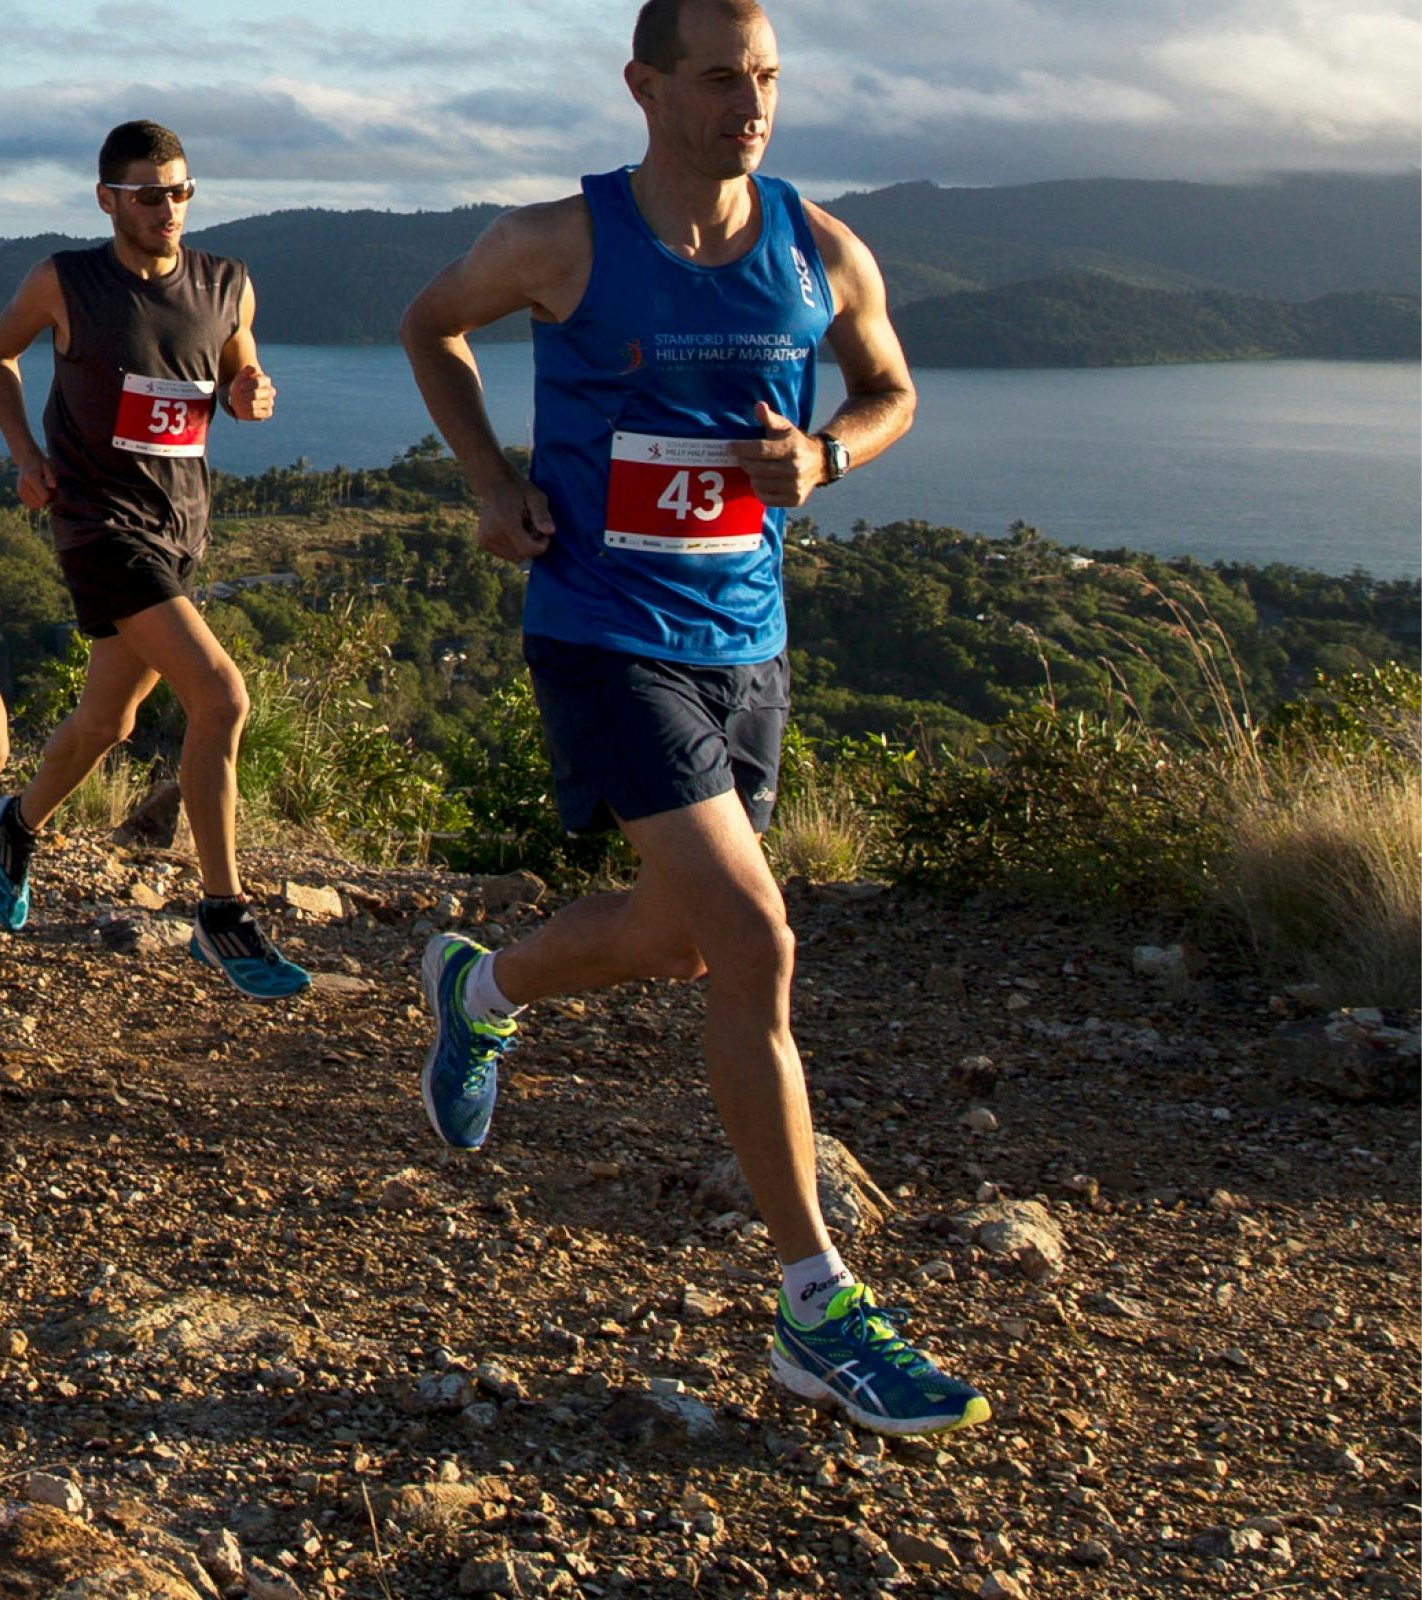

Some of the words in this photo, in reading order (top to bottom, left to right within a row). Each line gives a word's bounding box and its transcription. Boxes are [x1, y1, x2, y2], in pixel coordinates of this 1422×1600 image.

[655, 334, 724, 346] STAMFORD
[729, 333, 793, 346] FINANCIAL
[656, 348, 694, 361] HILLY
[698, 348, 735, 361] HALF
[739, 347, 810, 362] MARATHON
[147, 400, 188, 435] 53
[687, 449, 706, 457] HALF
[708, 449, 731, 457] MARA
[657, 470, 724, 521] 43
